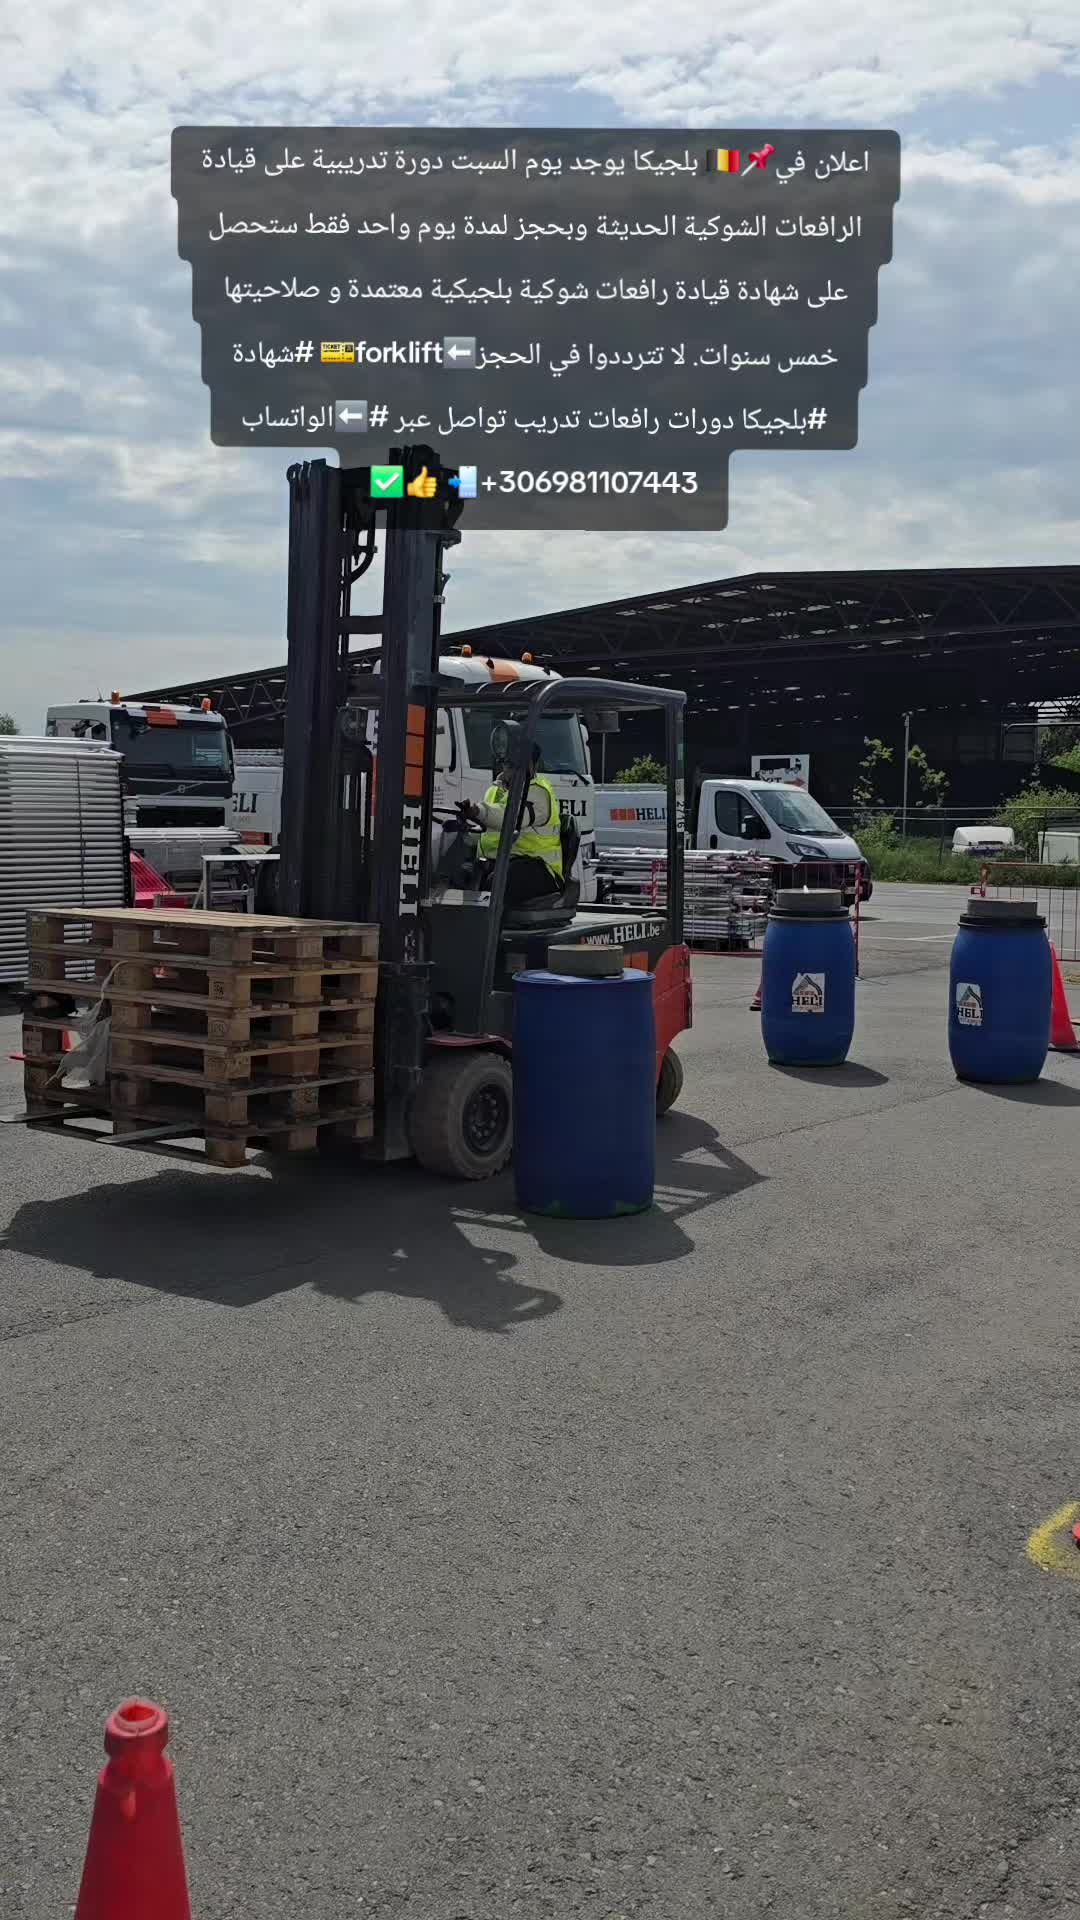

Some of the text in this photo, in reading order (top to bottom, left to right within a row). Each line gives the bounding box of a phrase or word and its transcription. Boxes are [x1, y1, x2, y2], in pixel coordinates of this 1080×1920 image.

[557, 799, 587, 817] ELI
[399, 804, 422, 917] HELI
[586, 922, 661, 945] www.HELI.be
[791, 996, 823, 1006] HELI
